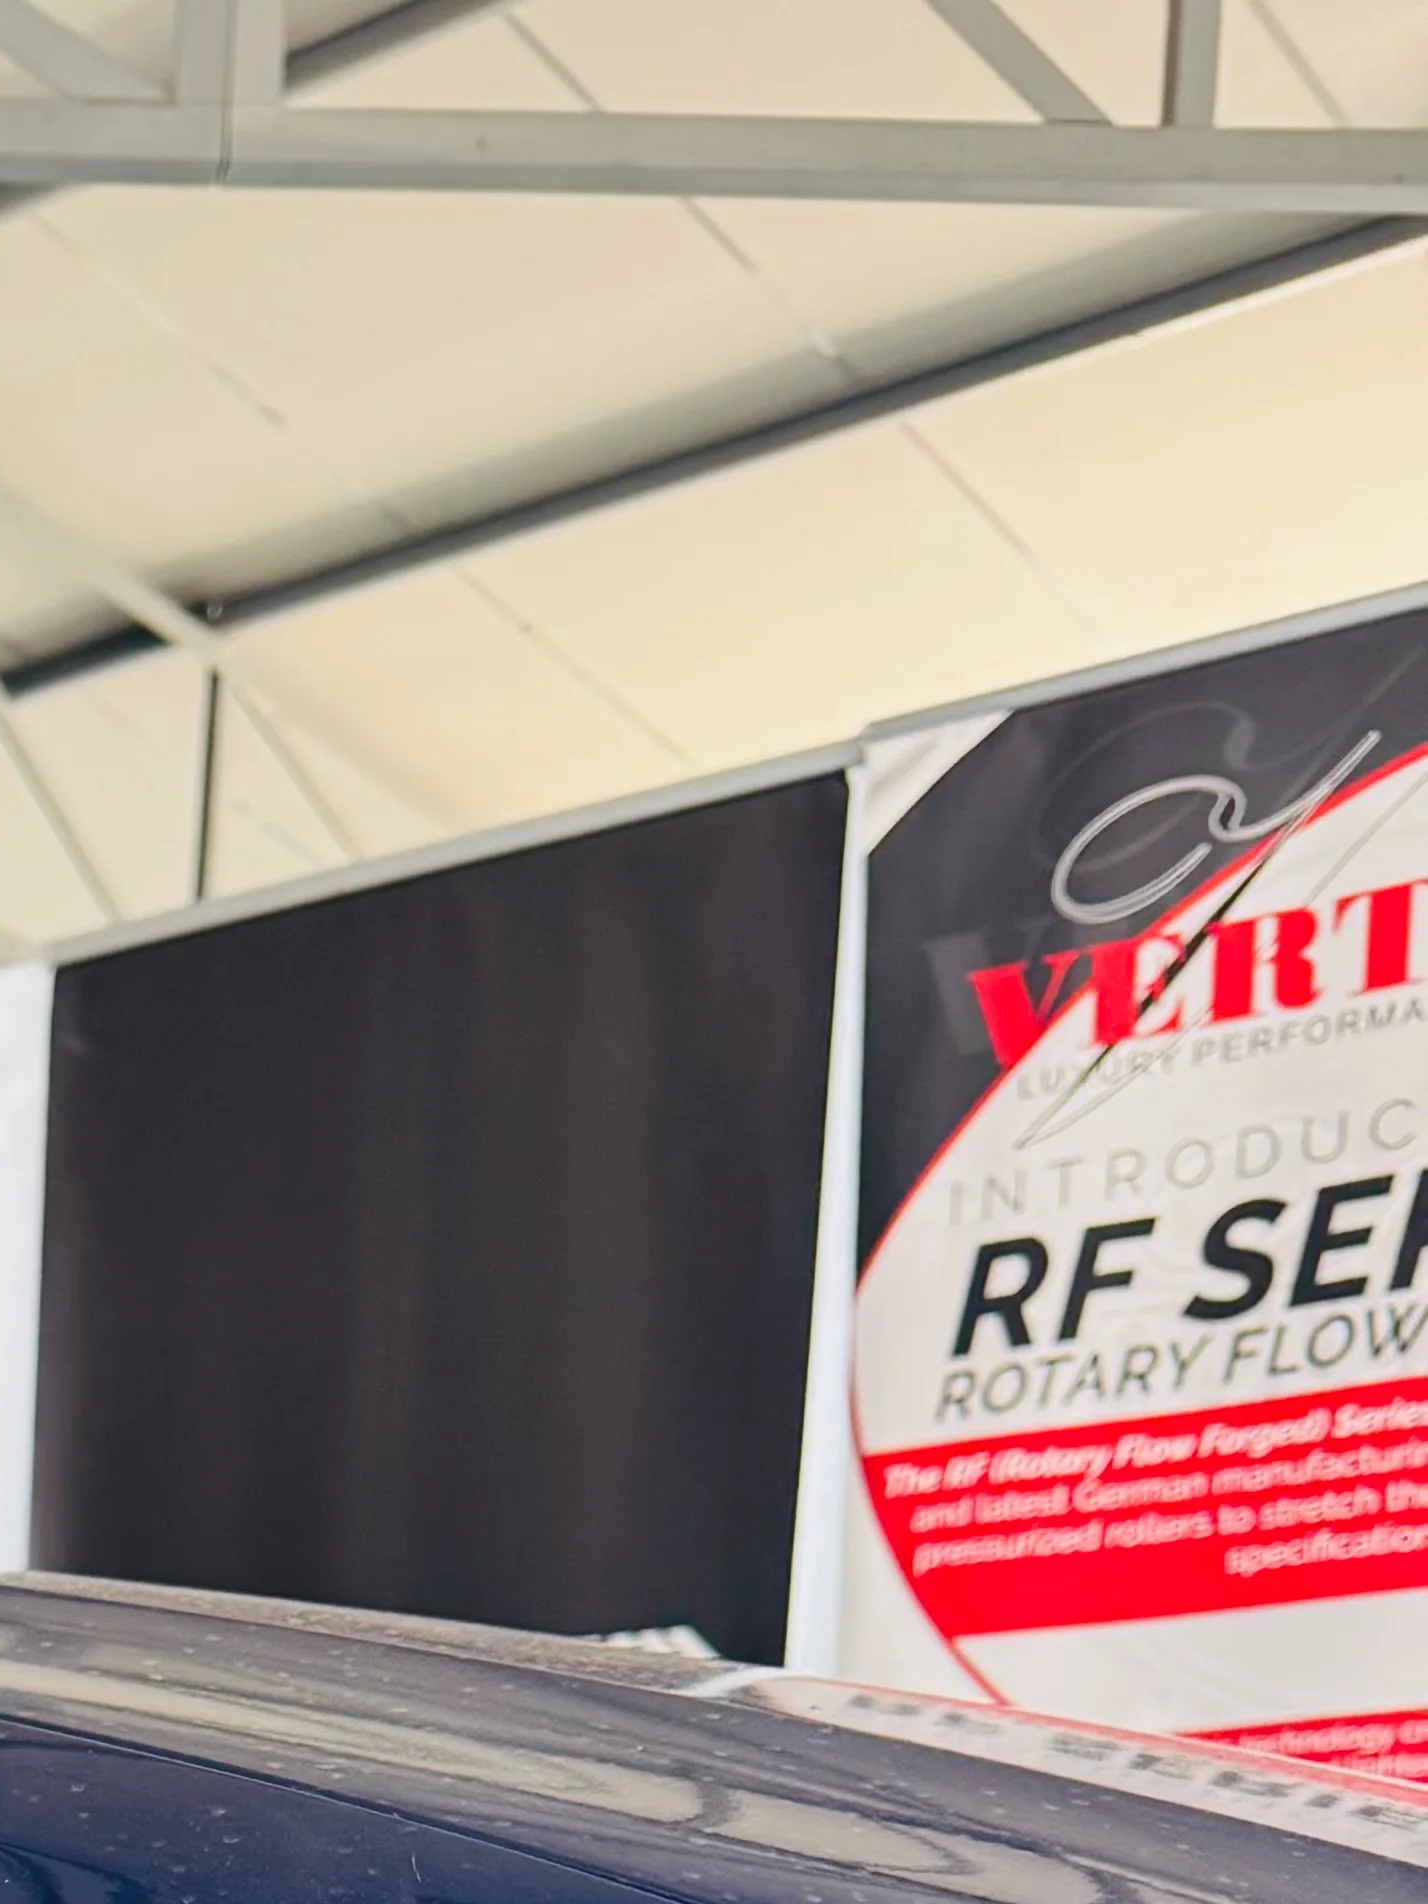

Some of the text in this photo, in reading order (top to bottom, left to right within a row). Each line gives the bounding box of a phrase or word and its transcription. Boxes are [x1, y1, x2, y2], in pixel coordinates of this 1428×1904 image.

[949, 1098, 1417, 1226] INTRODUC
[952, 1216, 1158, 1358] RF
[937, 1302, 1428, 1420] ROTARY FLOW
